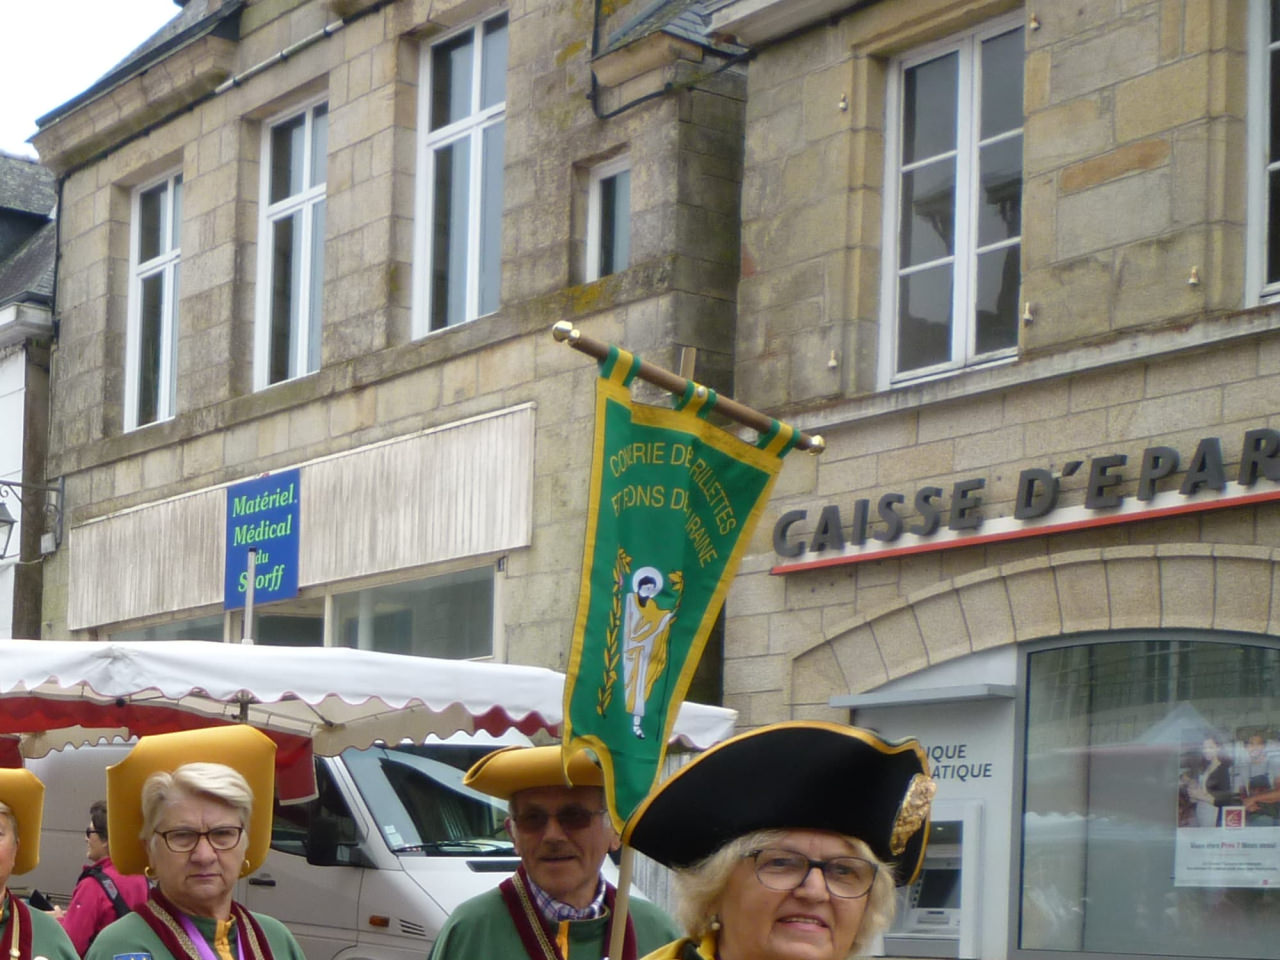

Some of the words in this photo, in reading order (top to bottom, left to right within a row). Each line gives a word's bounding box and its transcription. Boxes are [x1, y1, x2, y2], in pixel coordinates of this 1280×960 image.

[232, 483, 295, 517] Matériel
[233, 514, 293, 546] Médical
[772, 477, 987, 558] CAISSE
[255, 549, 269, 565] du
[238, 564, 285, 592] Sorff
[932, 763, 993, 782] ATIQUE
